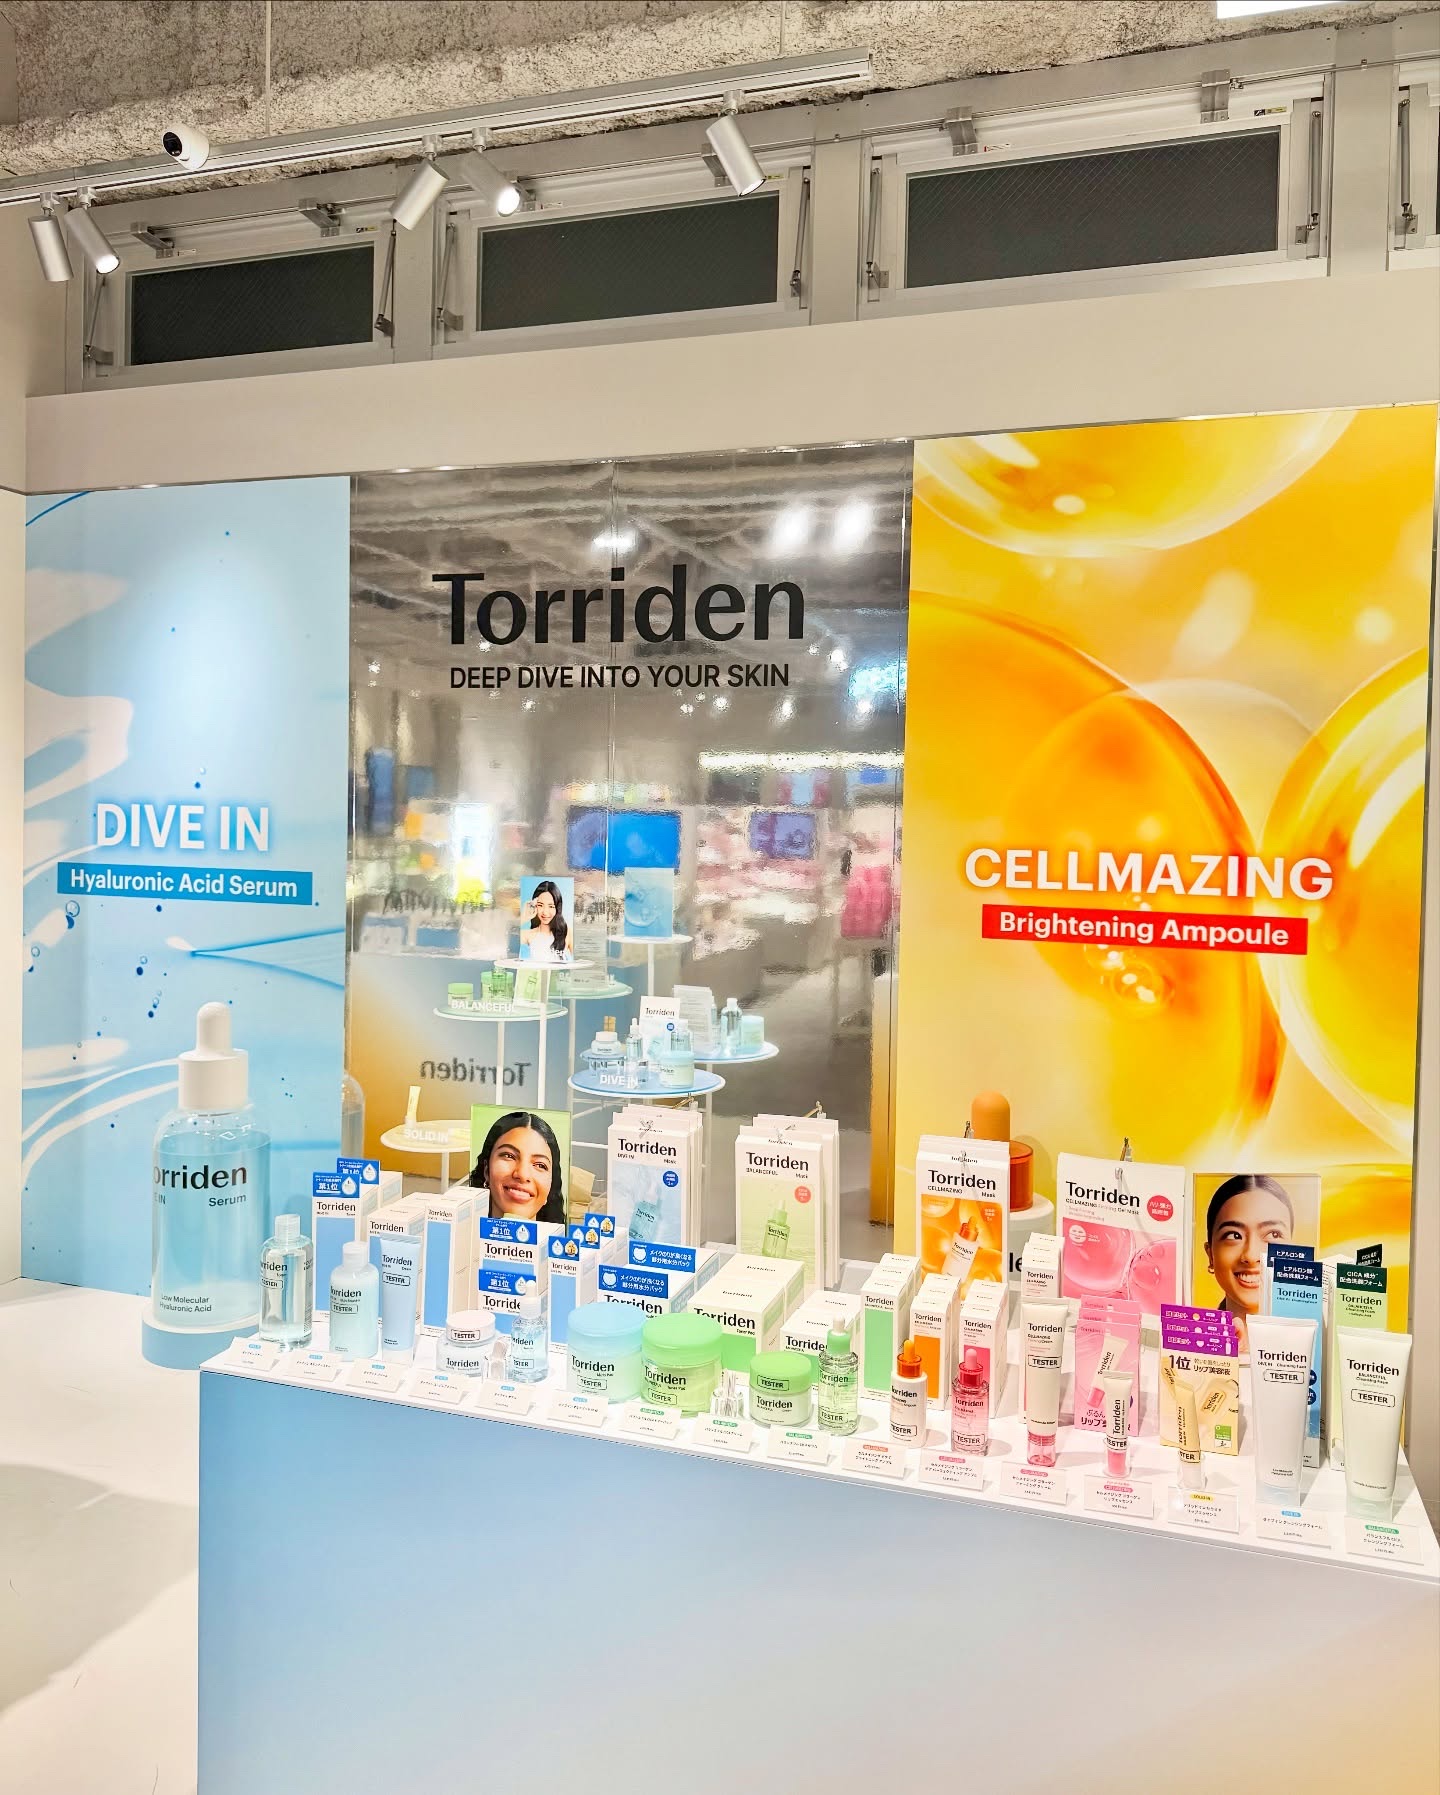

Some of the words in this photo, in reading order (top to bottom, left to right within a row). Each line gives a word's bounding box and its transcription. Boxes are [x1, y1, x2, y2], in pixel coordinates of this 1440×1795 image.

[432, 564, 804, 645] Torriden
[450, 666, 511, 689] DEEP
[518, 666, 574, 688] DIVE
[580, 665, 641, 688] INTO
[648, 664, 720, 687] YOUR
[727, 663, 789, 687] SKIN
[97, 803, 205, 849] DIVE
[219, 806, 269, 851] IN
[965, 848, 1334, 900] CELLMAZING
[71, 868, 174, 892] Hyaluronic
[178, 873, 224, 894] Acid
[229, 875, 297, 897] Serum
[999, 912, 1154, 944] Brightening
[1161, 919, 1289, 947] Ampoule
[600, 1075, 625, 1086] DIVE
[618, 1138, 677, 1157] Torriden
[746, 1151, 809, 1171] Torriden
[153, 1164, 247, 1190] orriden
[928, 1169, 996, 1191] Torriden
[1065, 1180, 1140, 1208] Torriden
[208, 1194, 247, 1207] Serum
[316, 1201, 356, 1212] Torriden
[370, 1220, 404, 1232] Torriden
[492, 1226, 511, 1236] 第1位
[484, 1242, 533, 1259] Torriden
[382, 1254, 412, 1266] Torriden
[552, 1262, 576, 1272] Torriden
[386, 1275, 406, 1284] TESTER
[1027, 1270, 1054, 1280] Torriden
[490, 1278, 510, 1288] 第1位
[330, 1286, 362, 1298] Torriden
[1276, 1288, 1318, 1300] Torriden
[161, 1294, 172, 1302] Low
[173, 1294, 210, 1304] Molecular
[483, 1294, 521, 1310] Torride
[866, 1296, 894, 1306] Torriden
[1340, 1294, 1382, 1306] Torriden
[194, 1304, 212, 1312] Acid
[333, 1304, 352, 1312] TESTER
[914, 1312, 942, 1323] Torriden
[964, 1320, 992, 1330] Torriden
[1028, 1322, 1063, 1333] Torriden
[786, 1336, 828, 1352] Torride
[1032, 1358, 1058, 1366] TESTER
[1168, 1354, 1192, 1371] 1位
[1258, 1350, 1307, 1363] Torriden
[446, 1358, 480, 1368] Torriden
[572, 1355, 615, 1372] Torriden
[1346, 1358, 1400, 1376] Torriden
[644, 1366, 686, 1386] Torriden
[1270, 1372, 1298, 1381] TESTER
[580, 1378, 602, 1388] TESTER
[761, 1380, 784, 1388] TESTER
[651, 1392, 672, 1402] TESTER
[892, 1386, 918, 1398] Torriden
[1358, 1392, 1388, 1404] TESTER
[756, 1396, 793, 1409] Torriden
[955, 1396, 984, 1407] Torriden
[821, 1412, 844, 1422] TESTER
[1112, 1399, 1121, 1435] Torriden
[890, 1424, 912, 1434] TESTER
[956, 1435, 981, 1444] TESTER
[1106, 1438, 1128, 1447] TESTER
